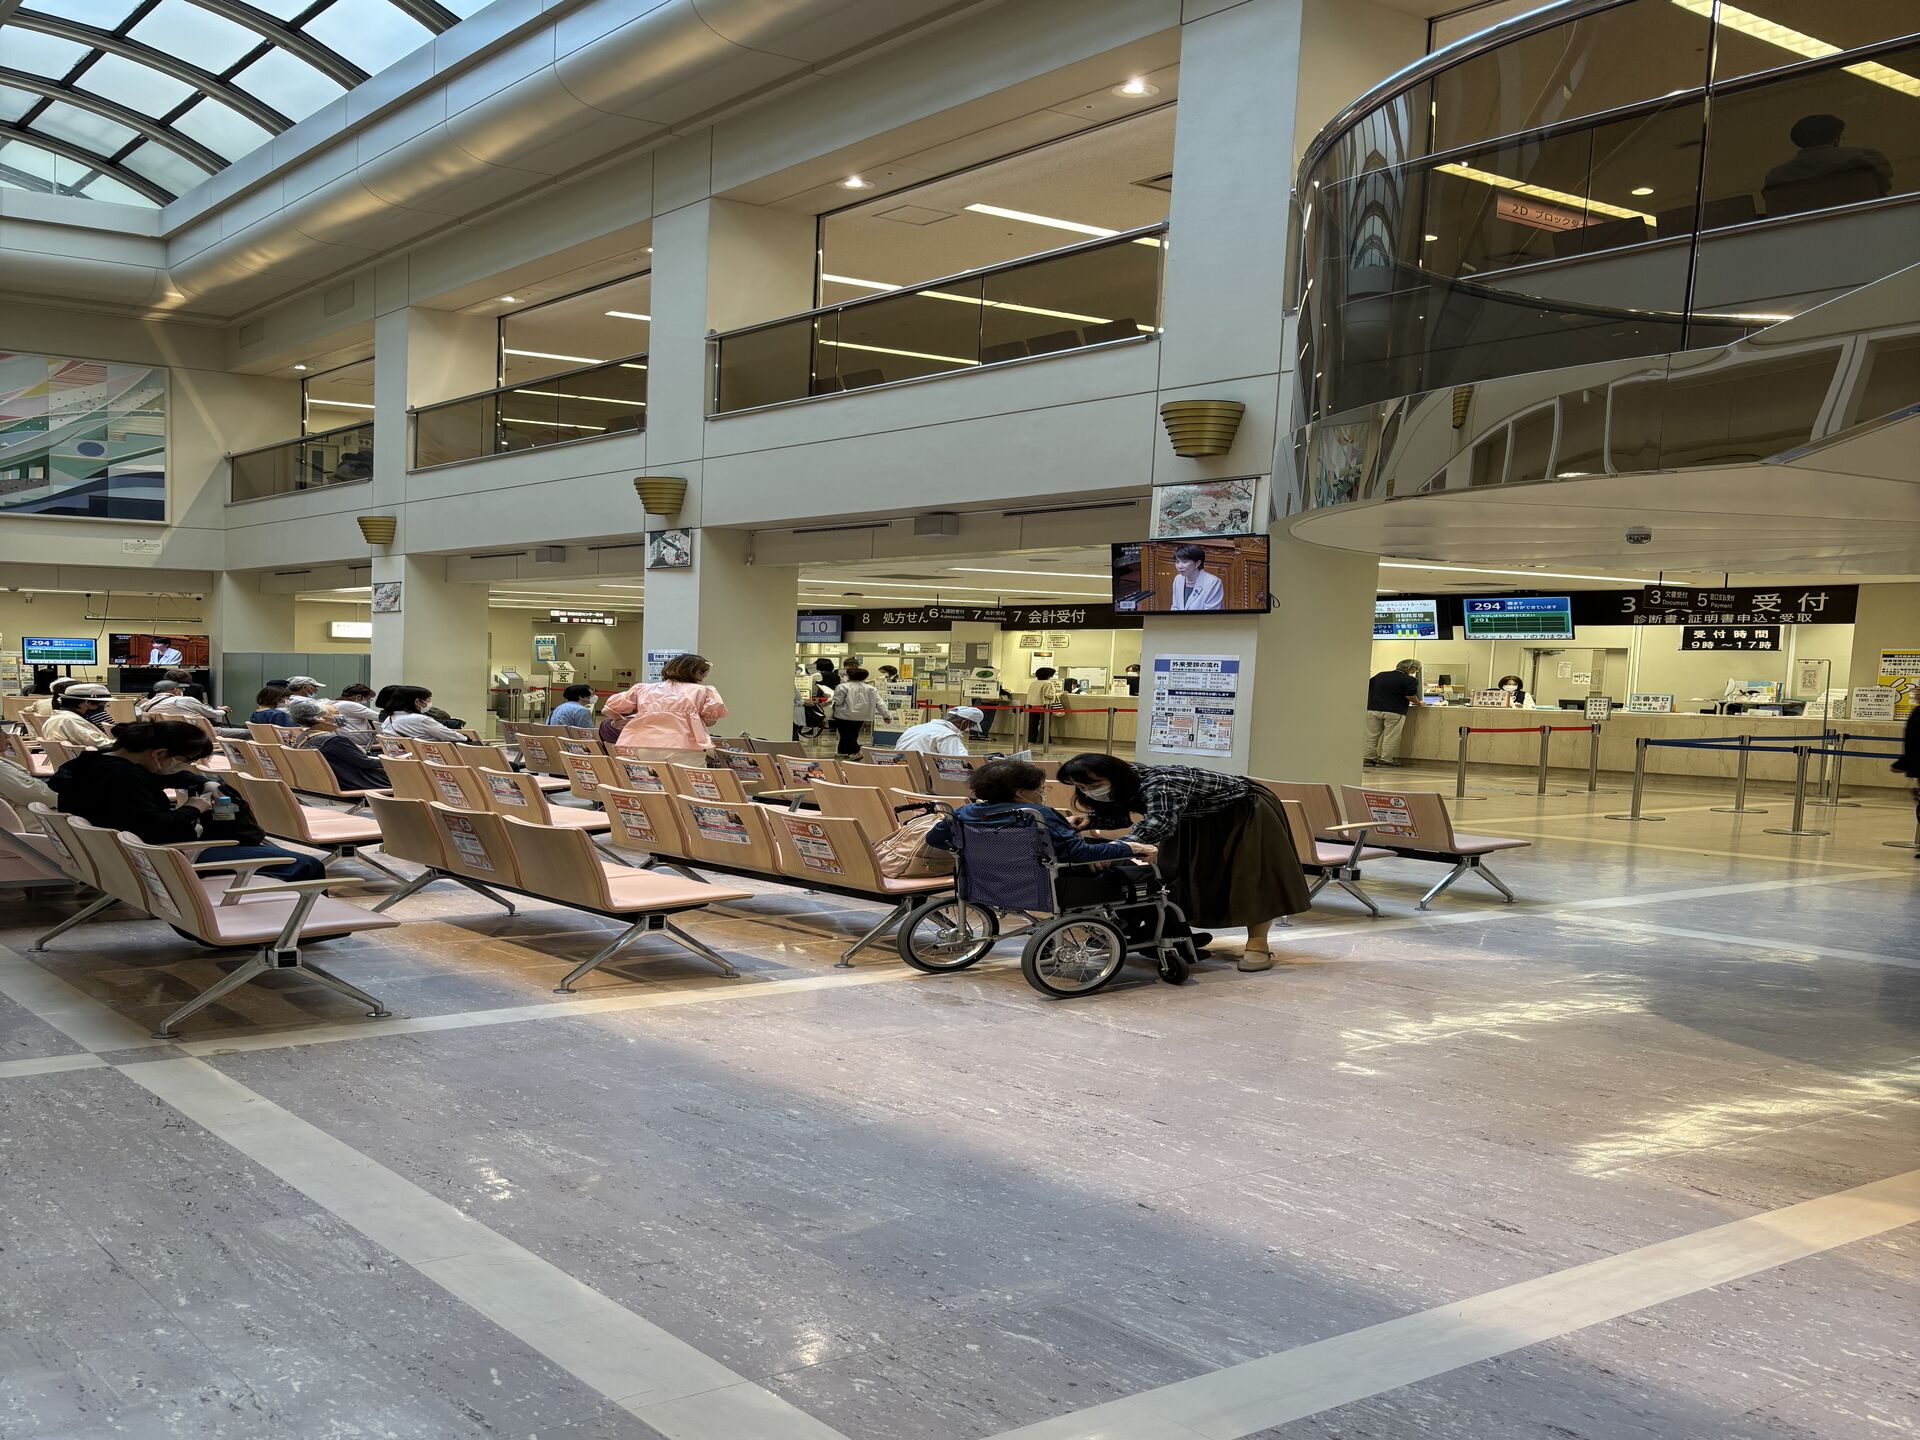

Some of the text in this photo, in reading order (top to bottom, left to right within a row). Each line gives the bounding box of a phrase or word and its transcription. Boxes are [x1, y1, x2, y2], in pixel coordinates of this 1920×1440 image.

[1511, 203, 1529, 216] 2D
[1650, 589, 1662, 604] 3
[1697, 592, 1708, 607] 5
[1474, 602, 1501, 611] 294
[1620, 596, 1637, 613] 3
[1662, 599, 1689, 607] Document
[862, 611, 929, 624] 8 処方せん
[928, 607, 939, 618] 6
[972, 610, 981, 620] 7
[1013, 609, 1086, 624] 7 会計受付
[1633, 613, 1813, 624] 診断書・証明書申込・受取
[810, 621, 828, 633] 10
[1693, 629, 1769, 639] 受付時間
